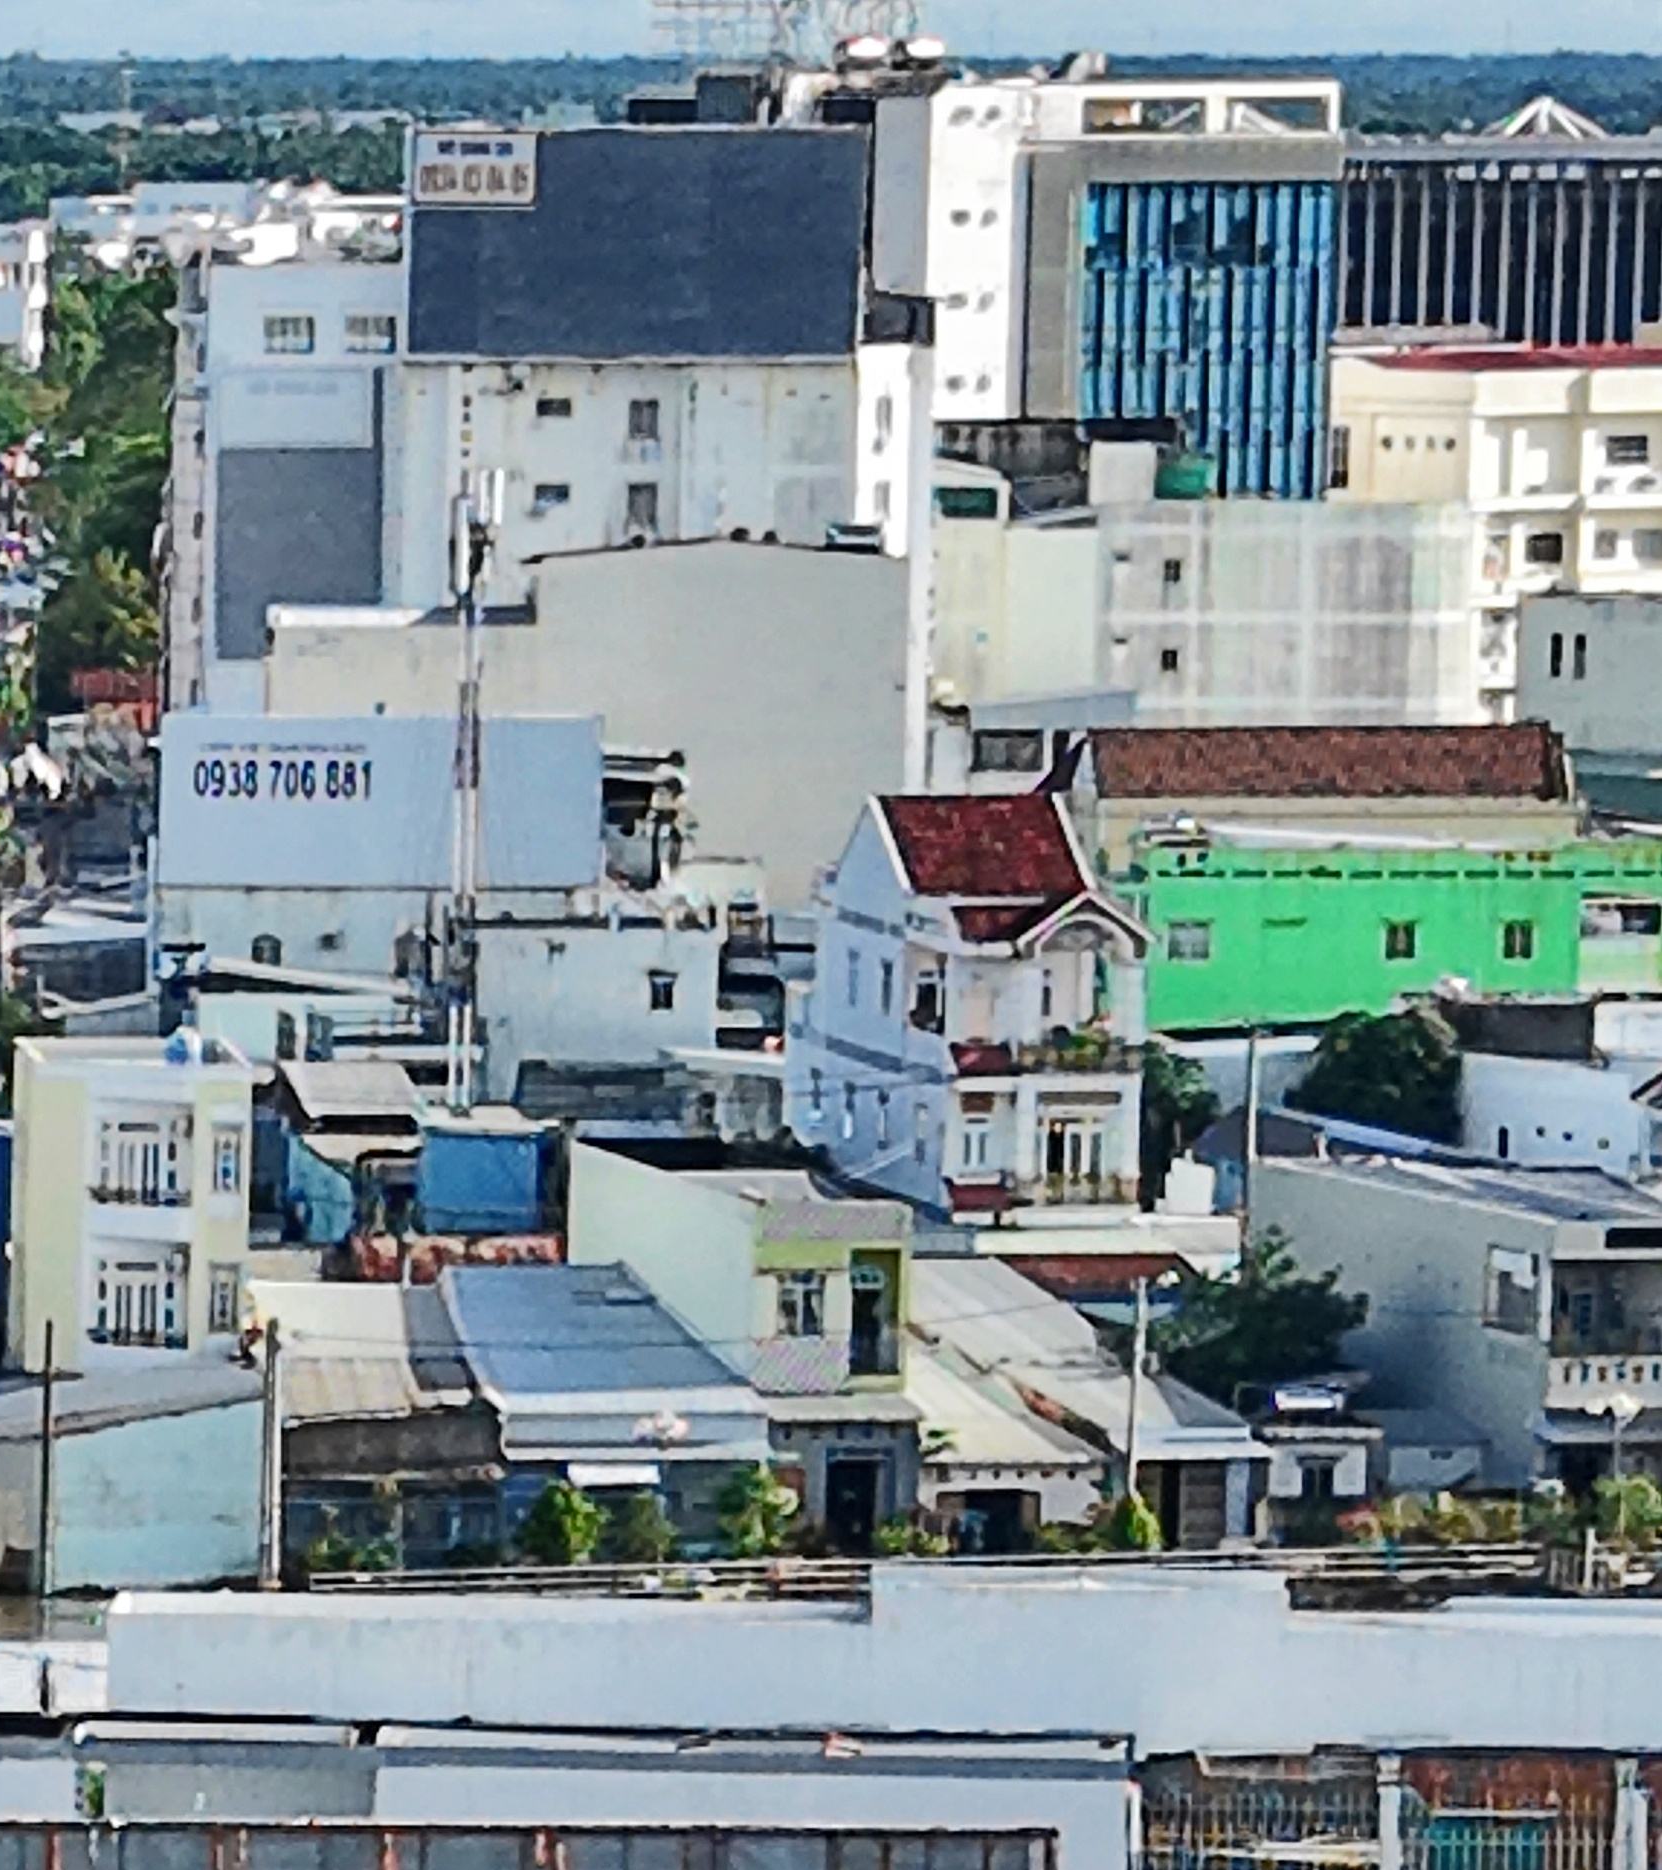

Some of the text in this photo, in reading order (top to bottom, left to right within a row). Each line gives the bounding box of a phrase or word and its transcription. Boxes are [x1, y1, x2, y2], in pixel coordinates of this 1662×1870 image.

[193, 759, 373, 801] 0938 706 881
